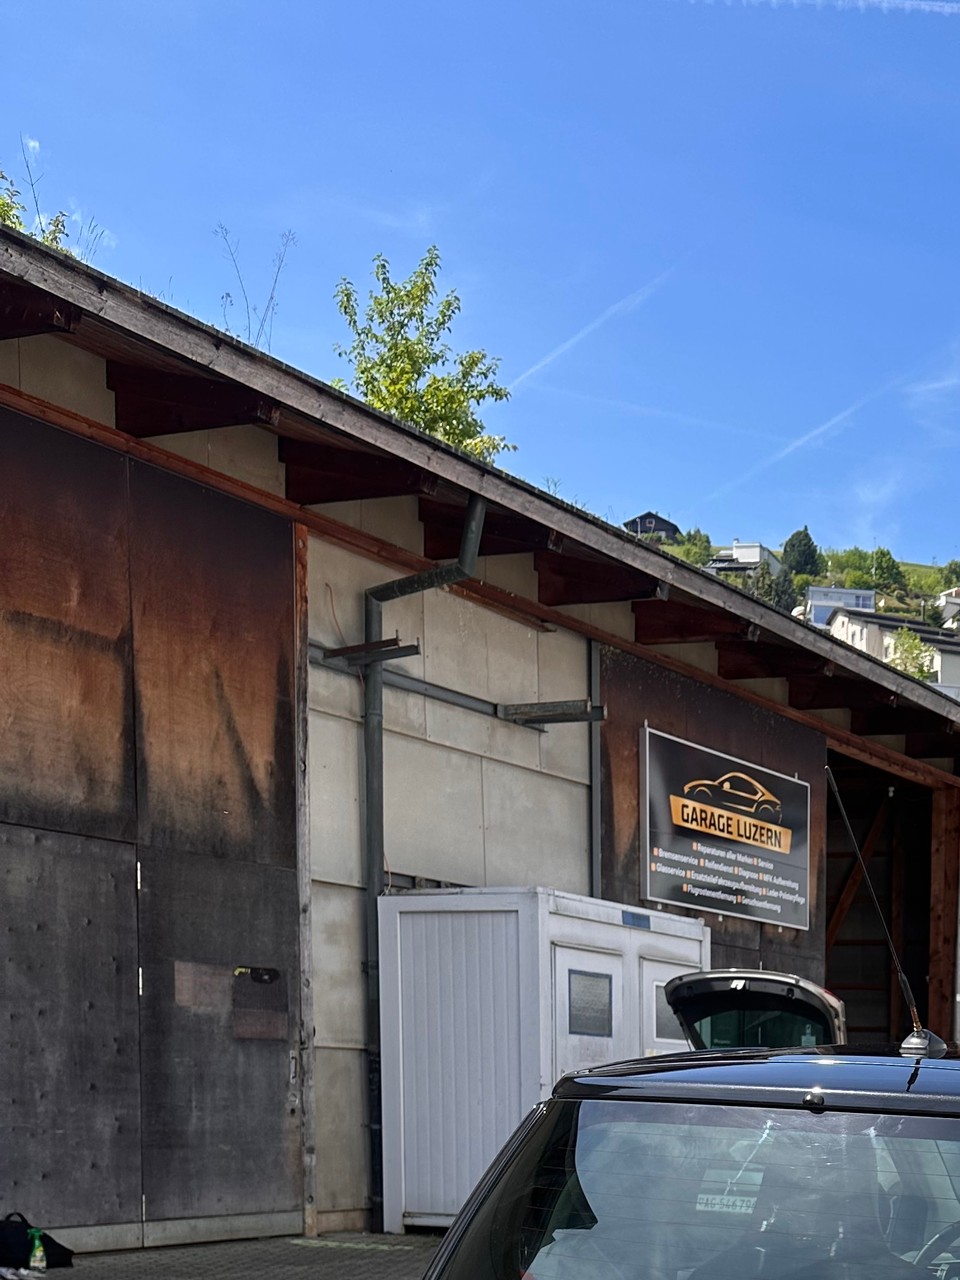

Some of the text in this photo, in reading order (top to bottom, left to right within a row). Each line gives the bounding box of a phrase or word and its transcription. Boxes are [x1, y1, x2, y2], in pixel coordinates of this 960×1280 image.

[681, 804, 782, 848] GARAGE LUZERN
[658, 848, 698, 866] Bremsenservice
[758, 858, 774, 870] Service
[656, 862, 686, 878] Glasservice
[739, 867, 759, 881] Diagnose
